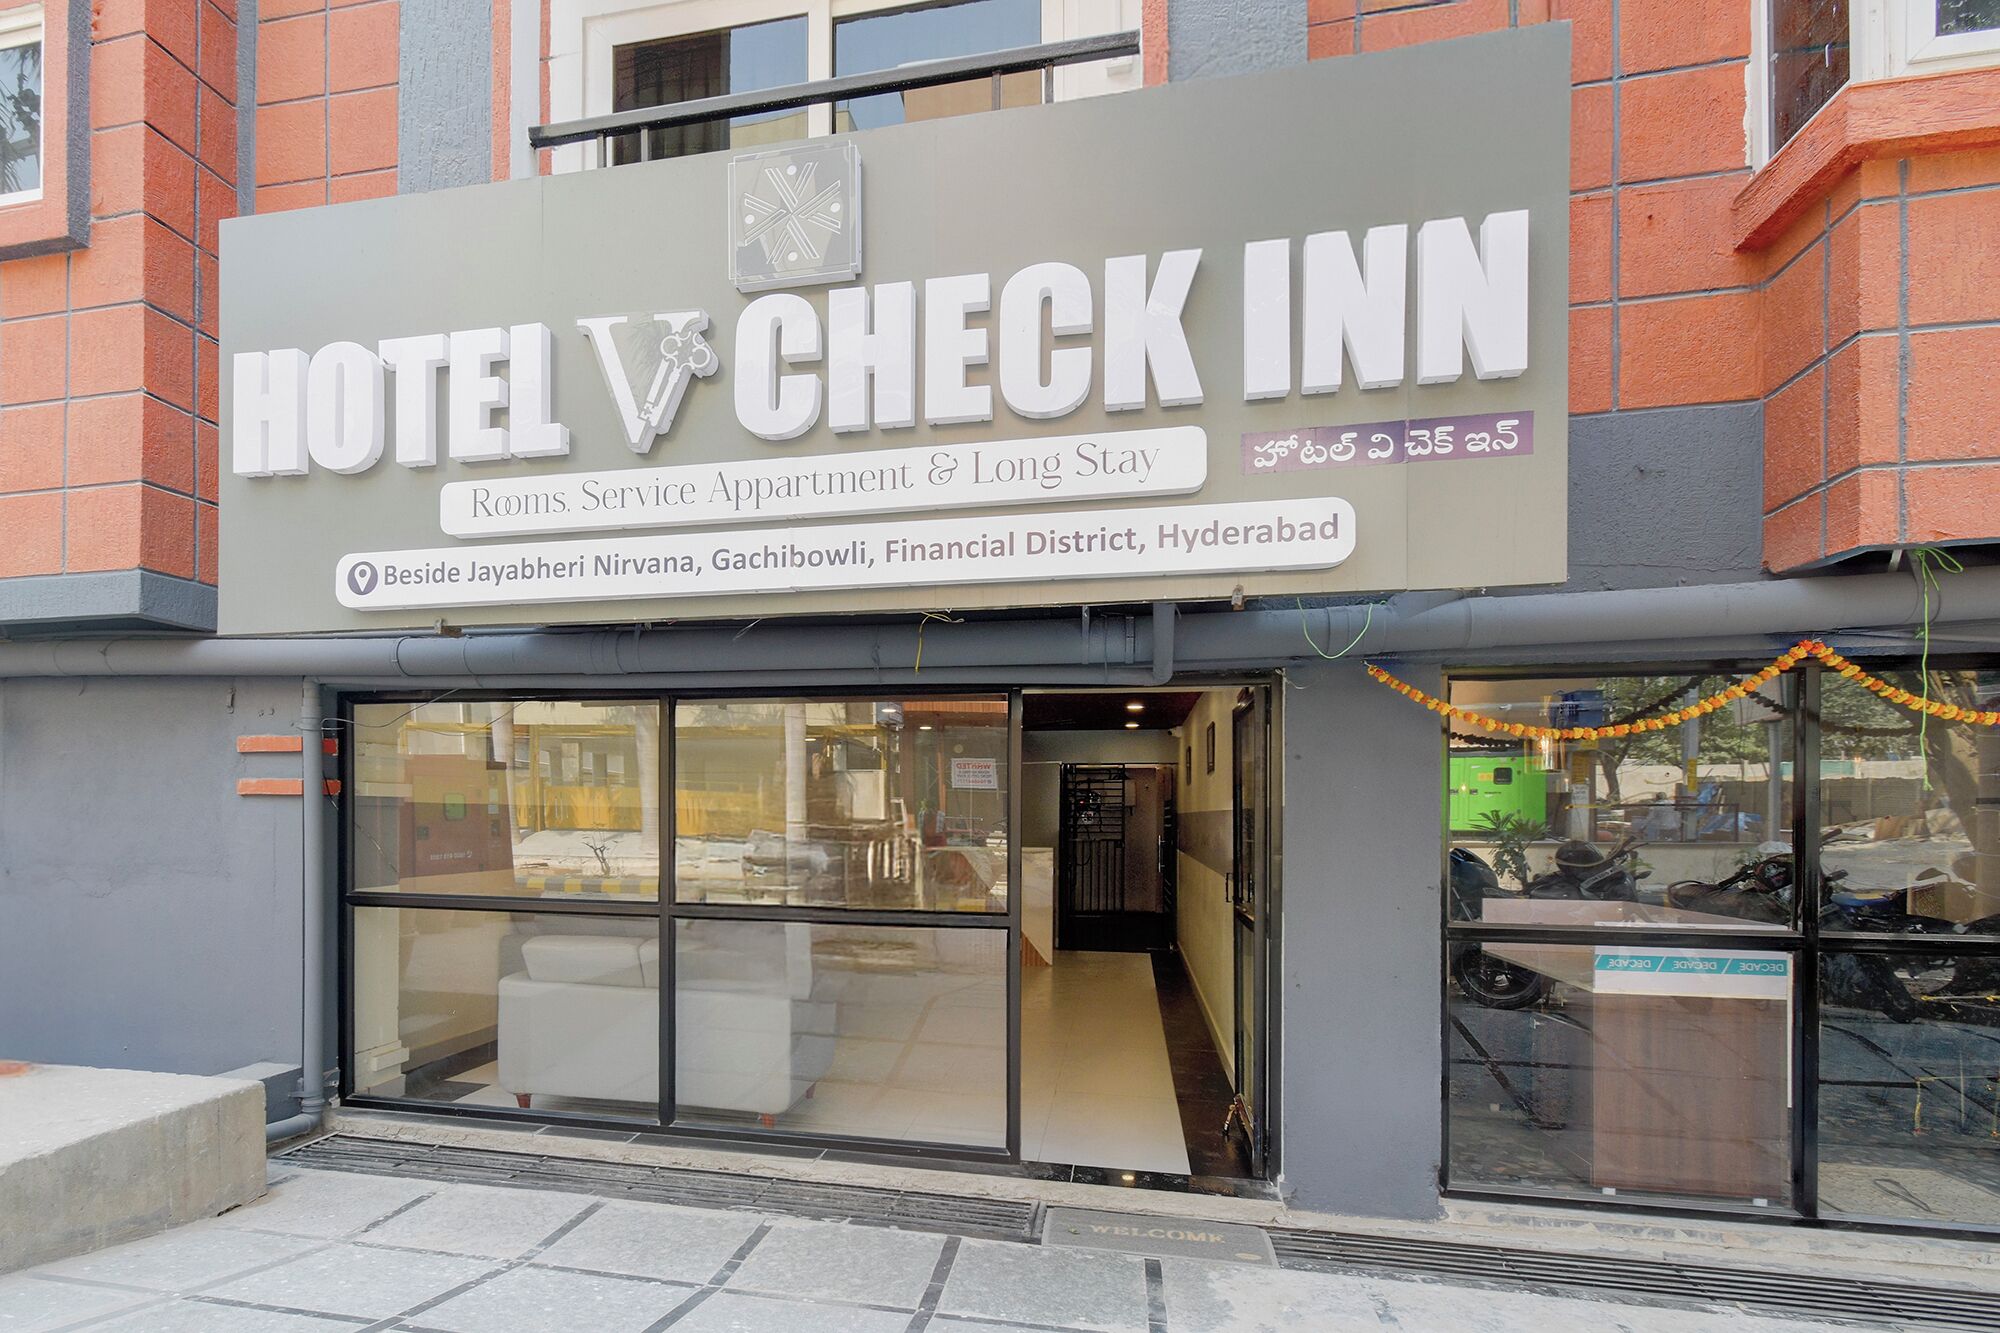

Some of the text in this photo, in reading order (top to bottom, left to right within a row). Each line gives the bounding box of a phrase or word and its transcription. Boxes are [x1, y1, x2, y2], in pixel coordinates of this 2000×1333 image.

[233, 209, 1529, 477] HOTEL V CHECK INN
[1254, 419, 1520, 468] హోటల్ వి చెక్ ఇన్
[471, 442, 1160, 518] Rooms. Service Appartment & Long Stay
[384, 513, 1339, 586] Beside Jayabheri Nirvana, Gachibowli, Financial District, Hyderabad
[1608, 958, 1785, 972] DECADE DECADE DECADE
[1090, 1224, 1226, 1244] WELCOME
